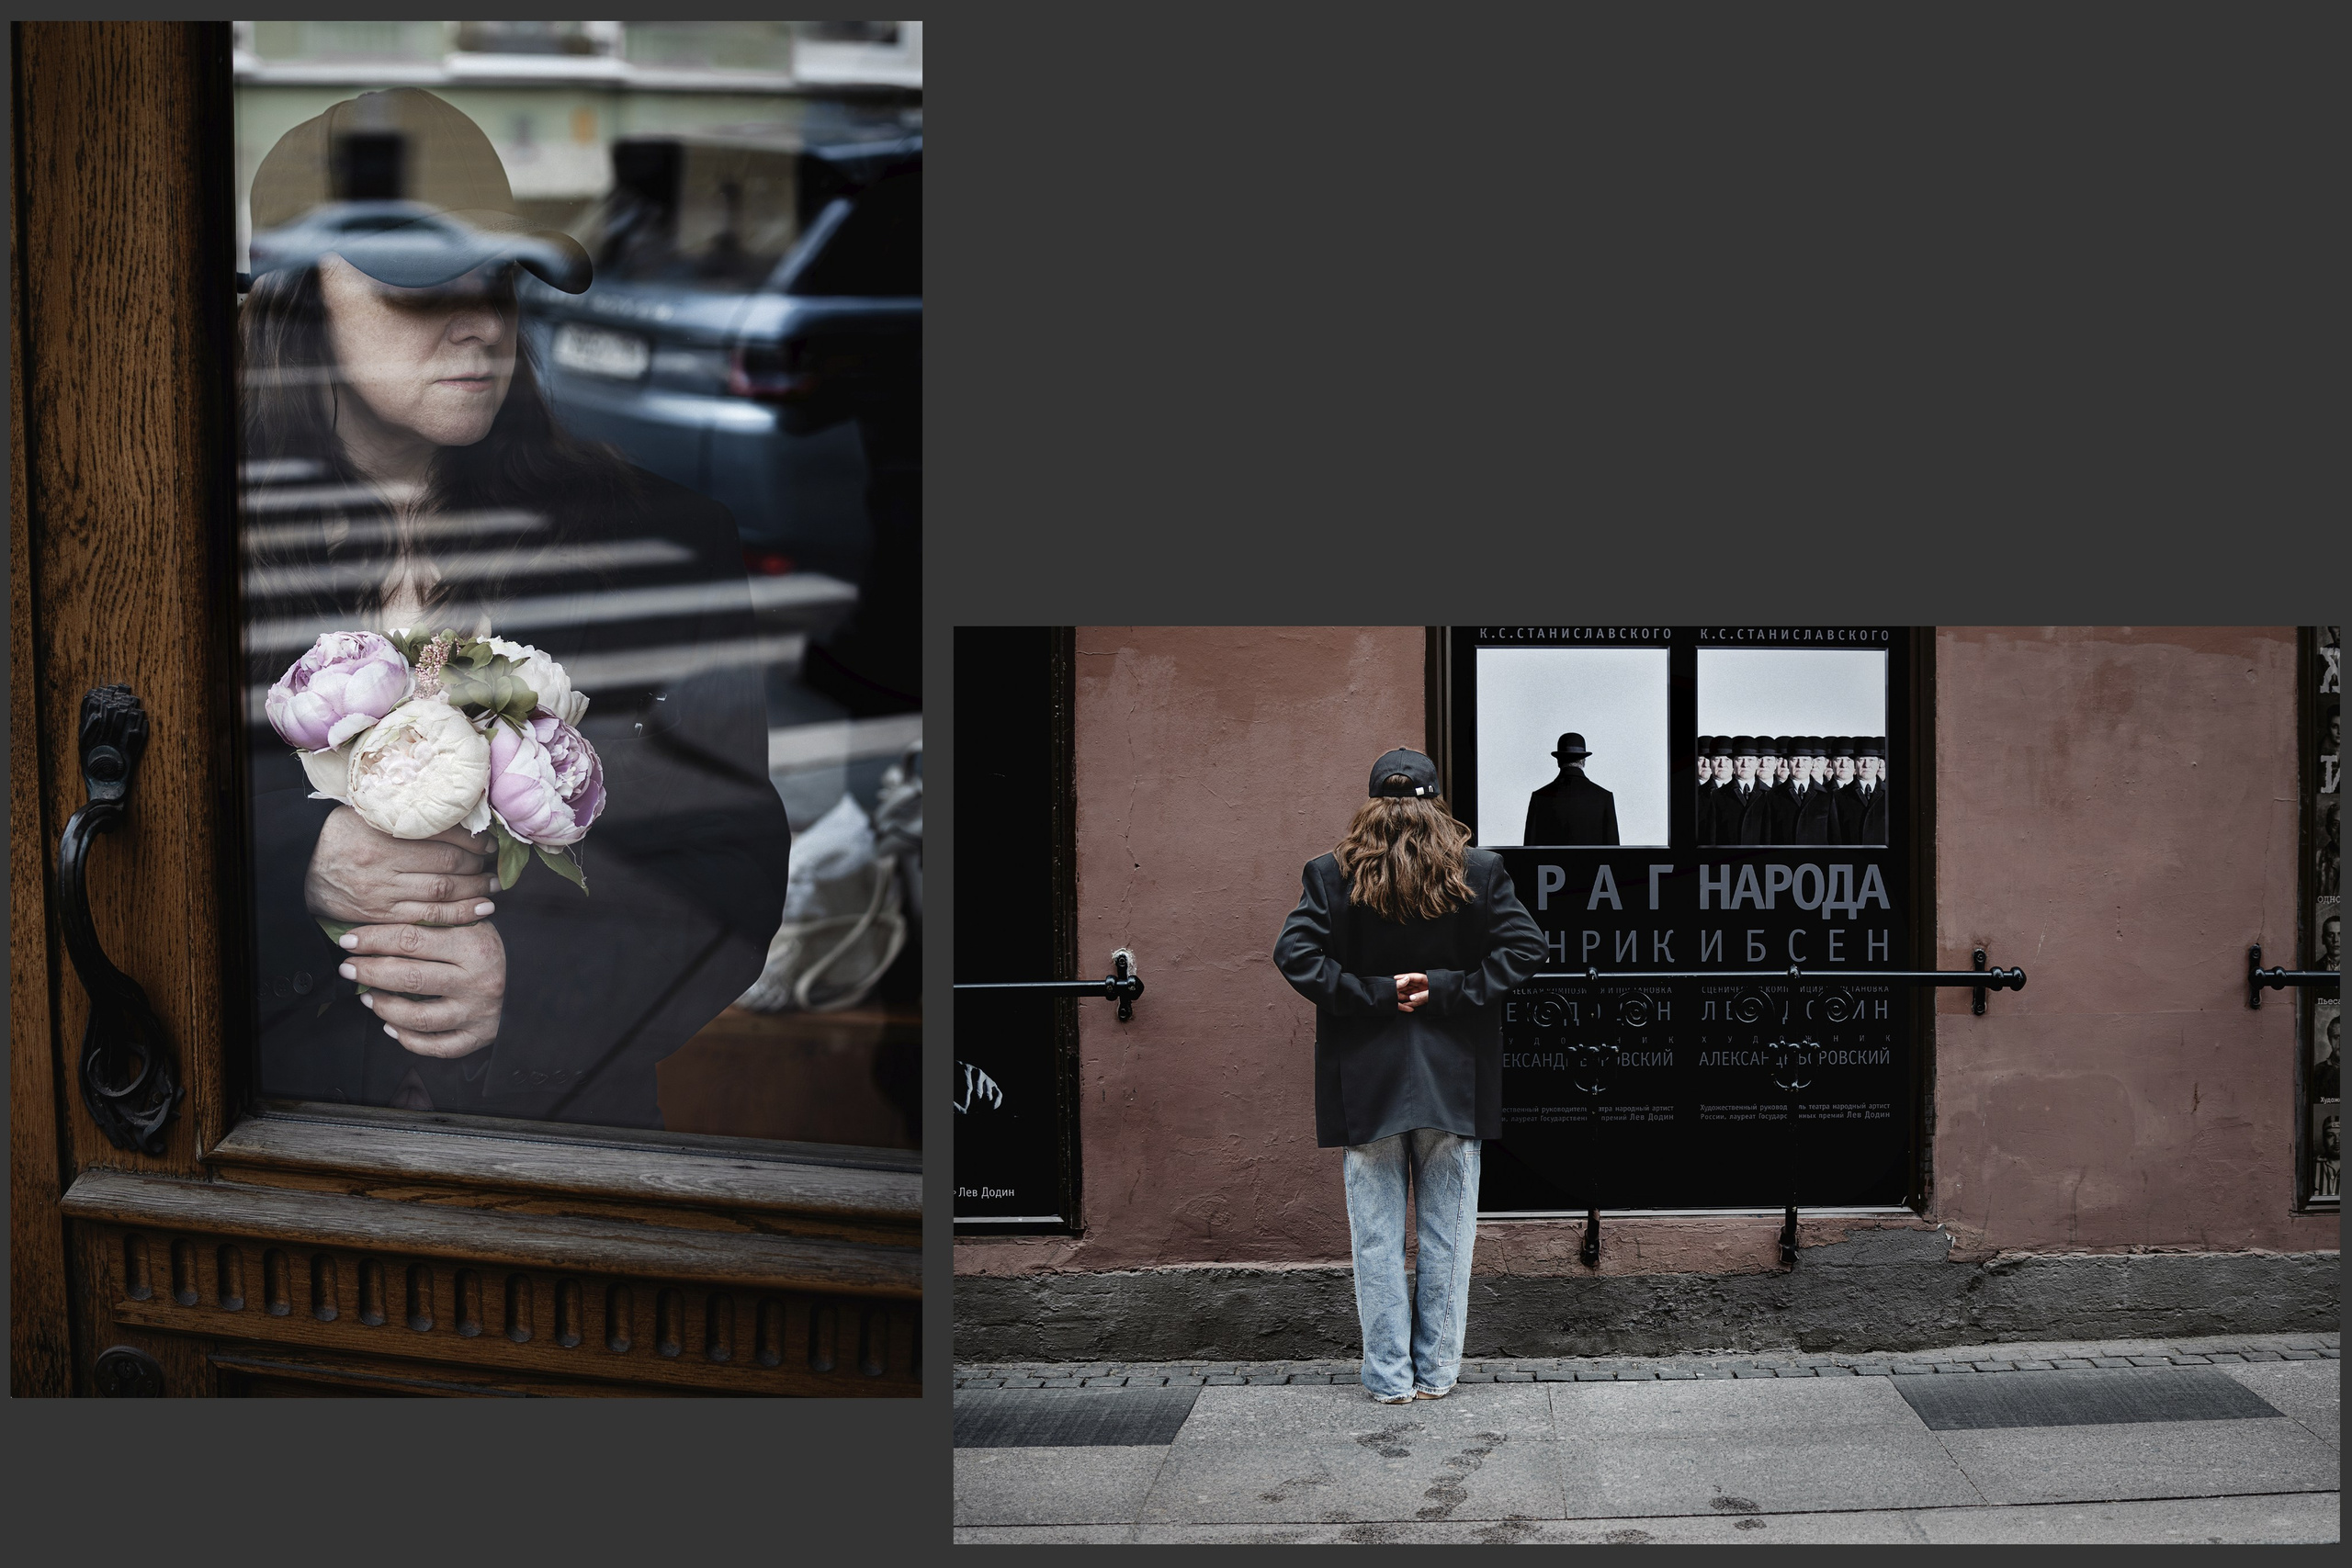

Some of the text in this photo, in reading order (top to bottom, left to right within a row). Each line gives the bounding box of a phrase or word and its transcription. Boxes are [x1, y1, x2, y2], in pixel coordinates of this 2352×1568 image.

[1479, 627, 1671, 639] К.С.СТАНИСЛАВСКОГО
[1700, 628, 1889, 641] К.С.СТАНИСЛАВСКОГО
[1699, 863, 1891, 919] НАРОДА
[1544, 930, 1675, 964] НРИК
[1701, 929, 1889, 963] ИБСЕН
[1503, 1053, 1568, 1070] ЕКСАНД
[1615, 1105, 1650, 1113] народный
[1700, 1103, 1758, 1112] Художественный
[1809, 1104, 1831, 1112] театра
[1832, 1102, 1867, 1111] народный
[1868, 1103, 1891, 1111] артист
[1629, 1112, 1645, 1121] Лев
[1647, 1112, 1674, 1122] Додин
[1846, 1111, 1862, 1119] Лев
[1864, 1111, 1891, 1120] Додин
[958, 1187, 978, 1197] Лев
[981, 1186, 1015, 1199] Додин
